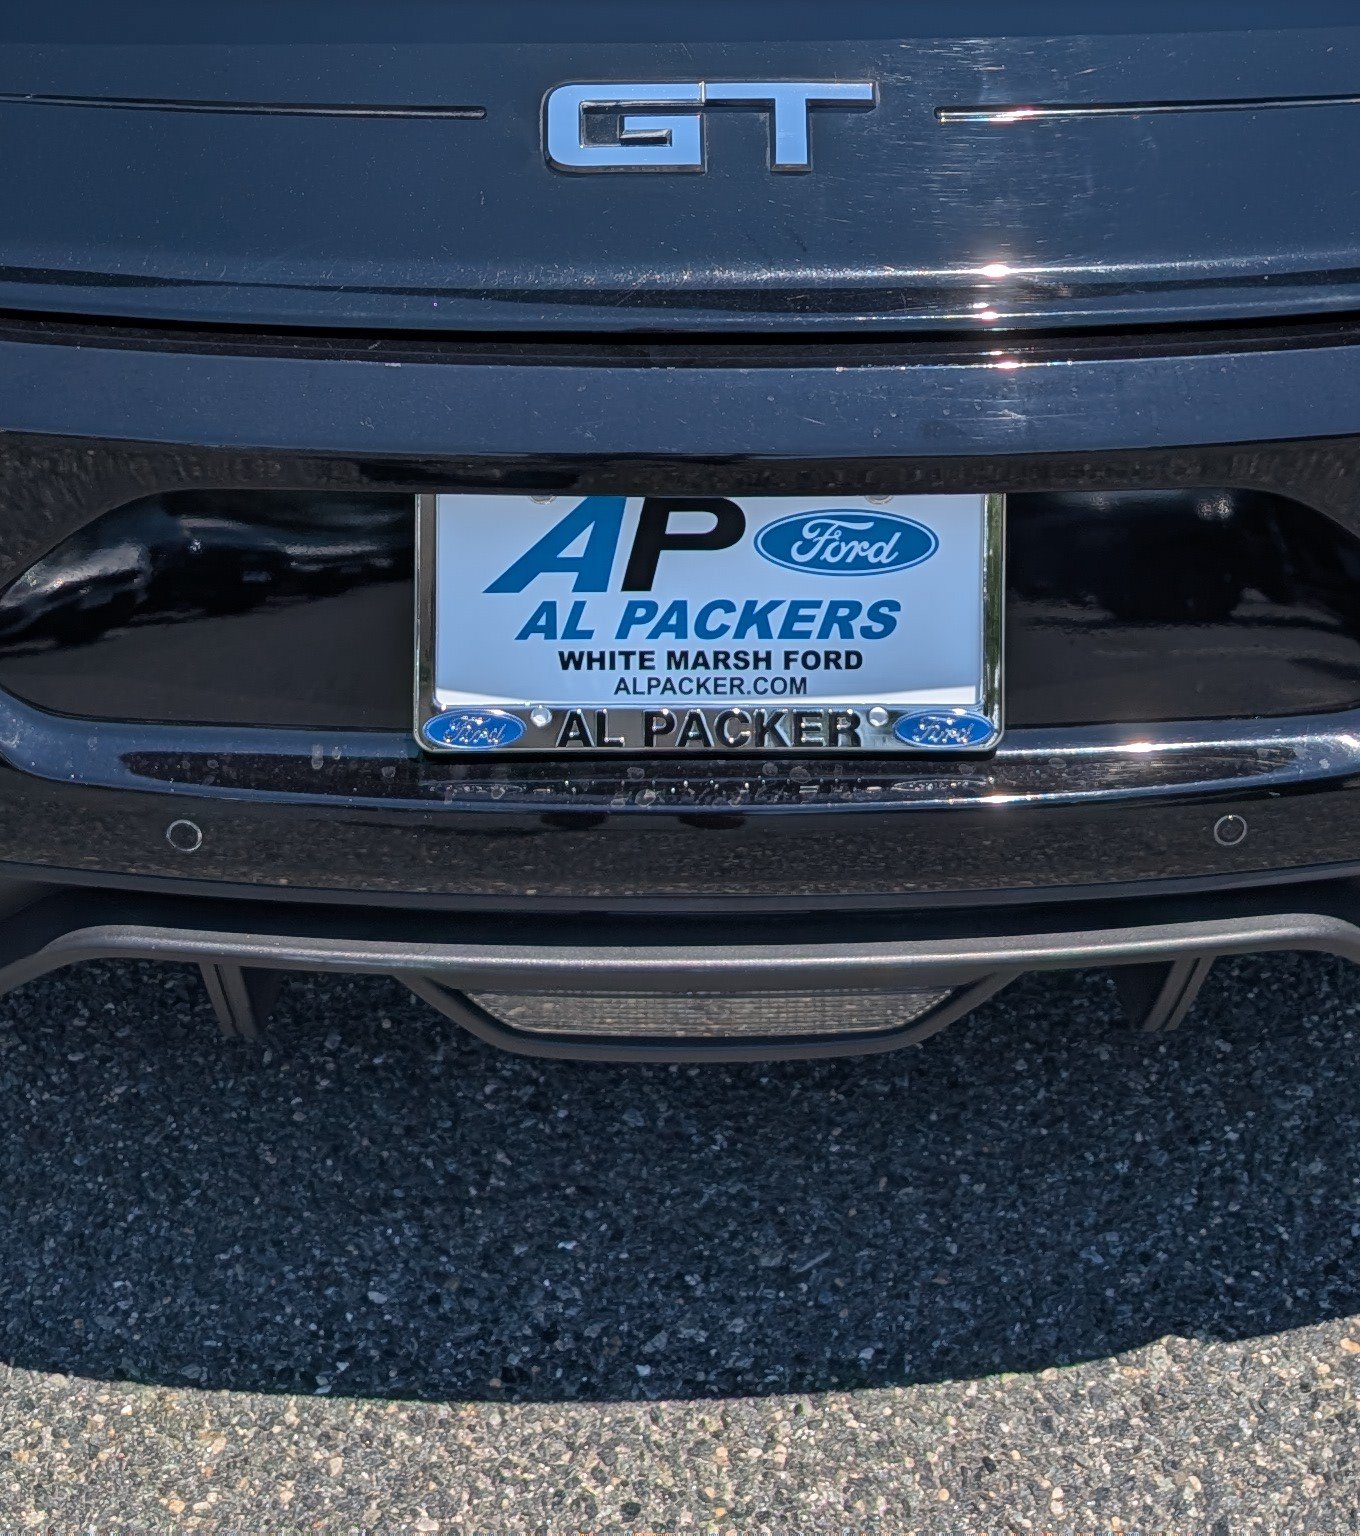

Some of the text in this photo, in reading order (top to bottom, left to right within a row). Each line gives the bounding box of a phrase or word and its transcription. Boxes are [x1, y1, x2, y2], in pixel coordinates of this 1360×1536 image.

[544, 80, 879, 174] GT
[482, 496, 746, 594] AP
[790, 517, 900, 565] Ford
[514, 599, 902, 641] AL PACKERS
[558, 650, 863, 671] WHITE MARSH FORD
[613, 676, 808, 696] ALPACKER.COM
[442, 715, 507, 744] Ford
[555, 707, 862, 749] AL PACKER
[911, 715, 974, 744] Ford
